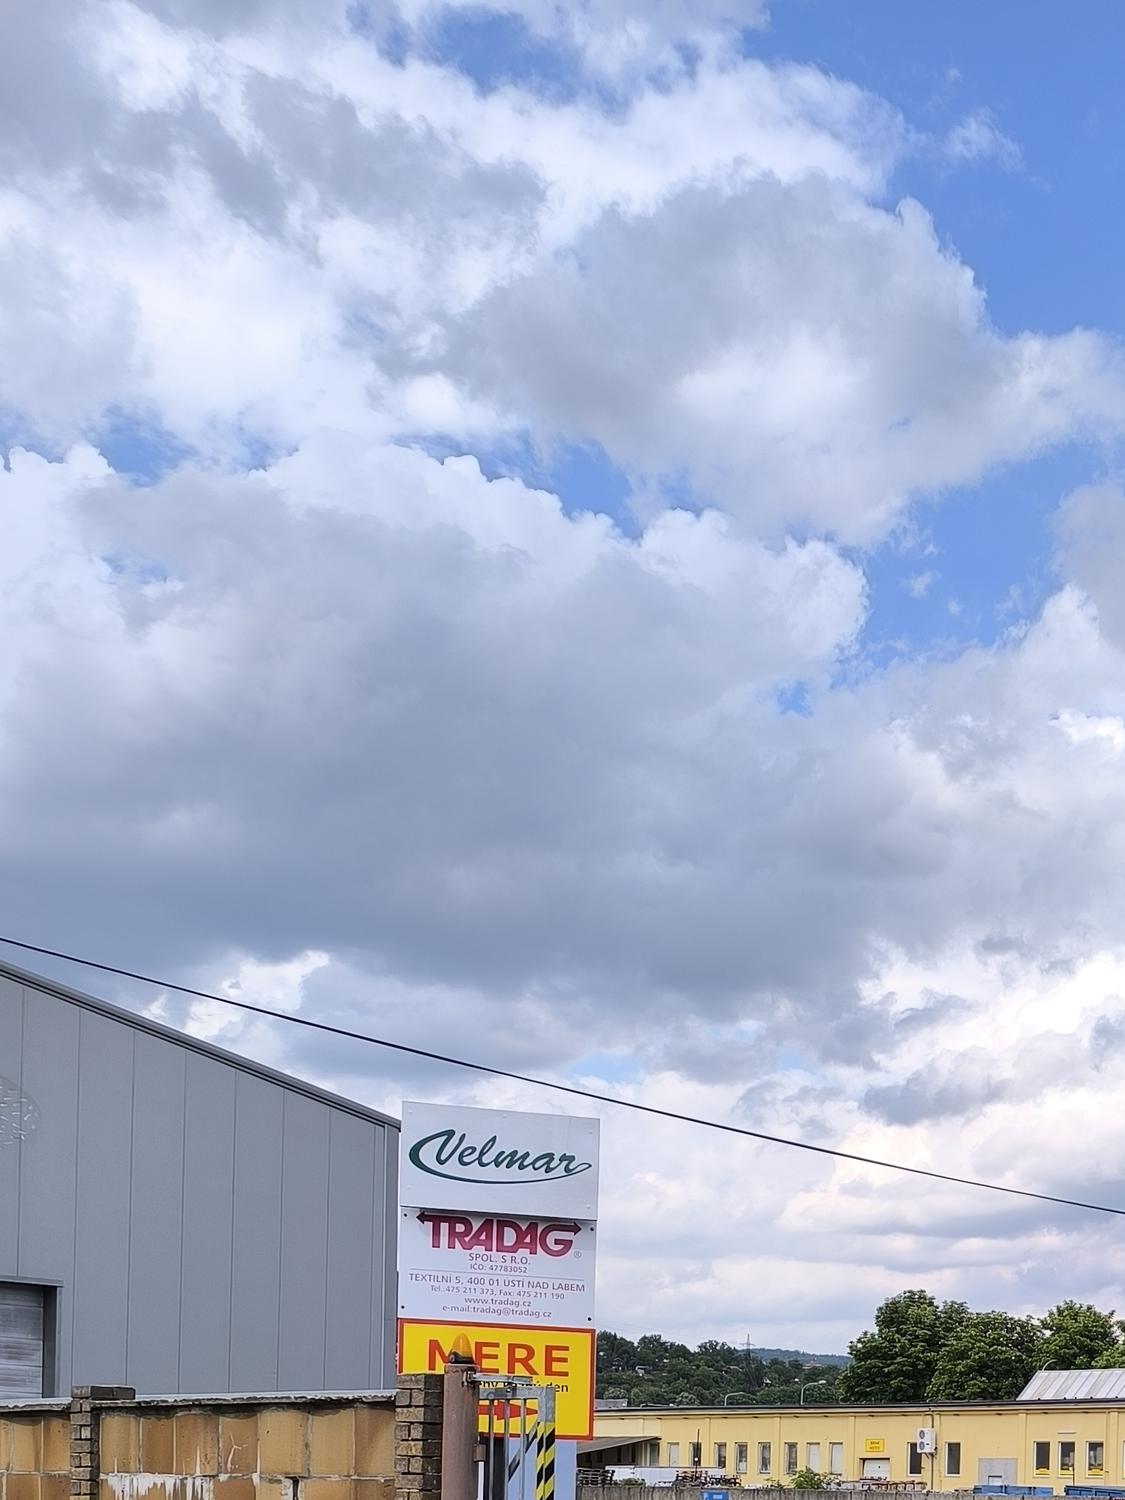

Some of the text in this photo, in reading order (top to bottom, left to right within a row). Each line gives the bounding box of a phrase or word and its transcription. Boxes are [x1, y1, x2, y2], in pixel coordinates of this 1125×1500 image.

[409, 1129, 592, 1184] Velmar
[416, 1211, 582, 1257] TRADAG
[468, 1252, 531, 1265] SPOL. S R.O.
[470, 1262, 528, 1274] IČO: 47783052
[409, 1272, 452, 1283] TEXTILNÍ
[455, 1275, 464, 1285] 5,
[467, 1277, 486, 1286] 400
[488, 1278, 500, 1287] 01
[527, 1280, 549, 1290] NAD
[552, 1282, 585, 1293] LABEM
[463, 1286, 477, 1294] 211
[500, 1289, 514, 1297] Fax:
[517, 1290, 531, 1298] 475
[533, 1291, 547, 1299] 211
[551, 1292, 565, 1300] 190
[464, 1297, 532, 1308] www.tradag.cz
[428, 1339, 570, 1377] MERE
